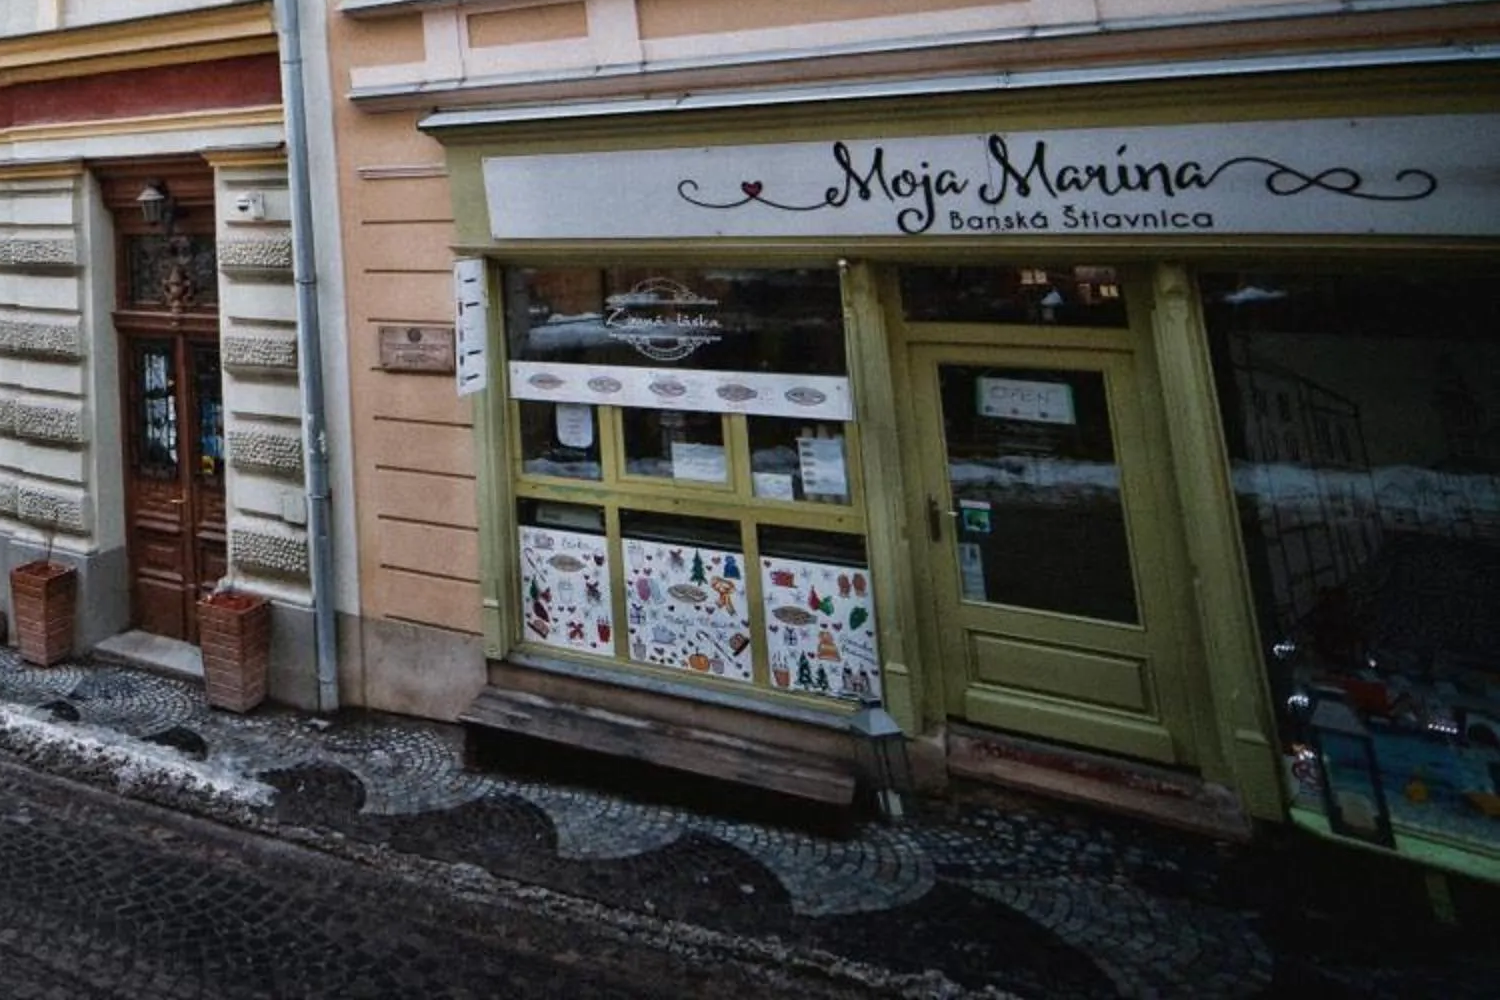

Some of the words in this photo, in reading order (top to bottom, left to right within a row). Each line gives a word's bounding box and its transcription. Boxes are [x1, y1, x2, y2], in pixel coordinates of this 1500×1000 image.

[825, 141, 969, 234] Moja
[979, 134, 1207, 204] Marína
[949, 210, 1049, 231] Banská
[1063, 204, 1214, 229] Štiavnica
